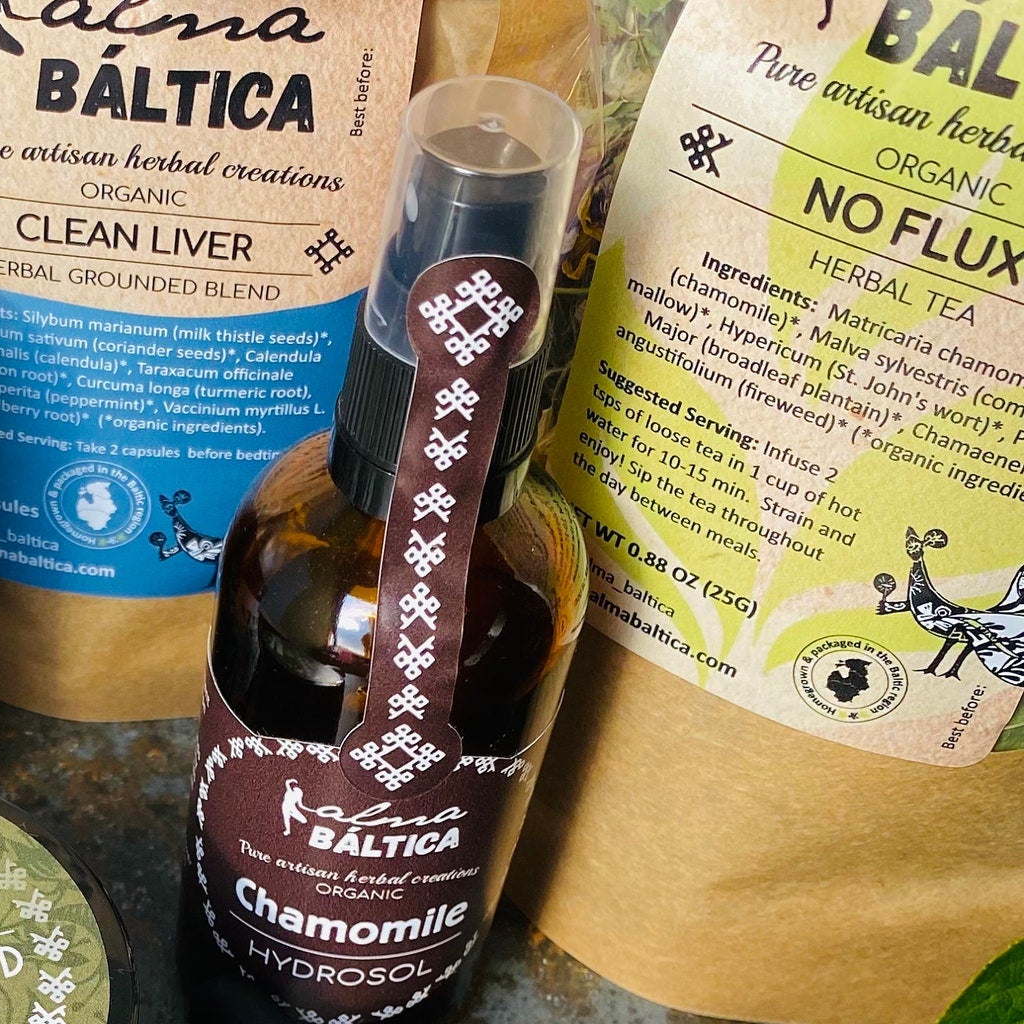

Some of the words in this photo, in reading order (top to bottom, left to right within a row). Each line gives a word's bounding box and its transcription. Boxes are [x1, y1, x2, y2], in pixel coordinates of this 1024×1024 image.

[36, 44, 315, 133] BÁLTICA
[746, 41, 817, 91] Pure
[822, 80, 932, 131] artisan
[21, 145, 118, 168] artisan
[124, 145, 215, 175] herbal
[221, 160, 345, 193] creations
[80, 182, 188, 207] ORGANIC
[876, 147, 1012, 206] ORGANIC
[15, 213, 139, 252] CLEAN
[151, 227, 252, 261] LIVER
[803, 177, 884, 233] NO
[890, 207, 1024, 286] FLUX
[68, 267, 198, 297] GROUNDED
[204, 280, 281, 301] BLEND
[701, 251, 819, 313] Ingredients:
[828, 303, 932, 356] Matricaria
[809, 249, 912, 306] HERBAL
[925, 289, 976, 327] TEA
[22, 309, 83, 331] Silybum
[88, 321, 168, 338] marianum
[173, 325, 212, 342] (milk
[216, 328, 265, 345] thistle
[245, 349, 322, 363] Calendula
[137, 361, 219, 380] Taraxacum
[223, 367, 293, 381] officinale
[598, 358, 683, 418] Suggested
[684, 405, 758, 452] Serving:
[762, 439, 822, 476] Infuse
[826, 466, 839, 484] 2
[660, 449, 709, 484] 10-15
[712, 476, 750, 503] min.
[760, 496, 815, 532] Strain
[630, 487, 701, 535] between
[706, 526, 761, 563] meals.
[595, 522, 625, 550] WT
[627, 542, 669, 574] 0.88
[671, 565, 701, 590] OZ
[703, 579, 758, 619] (25G)
[941, 726, 956, 751] Best
[952, 684, 987, 728] before:
[308, 826, 460, 858] BÁLTICA
[316, 802, 468, 828] alma
[235, 878, 468, 945] Chamomile
[316, 882, 404, 900] ORGANIC
[248, 940, 432, 987] HYDROSOL
